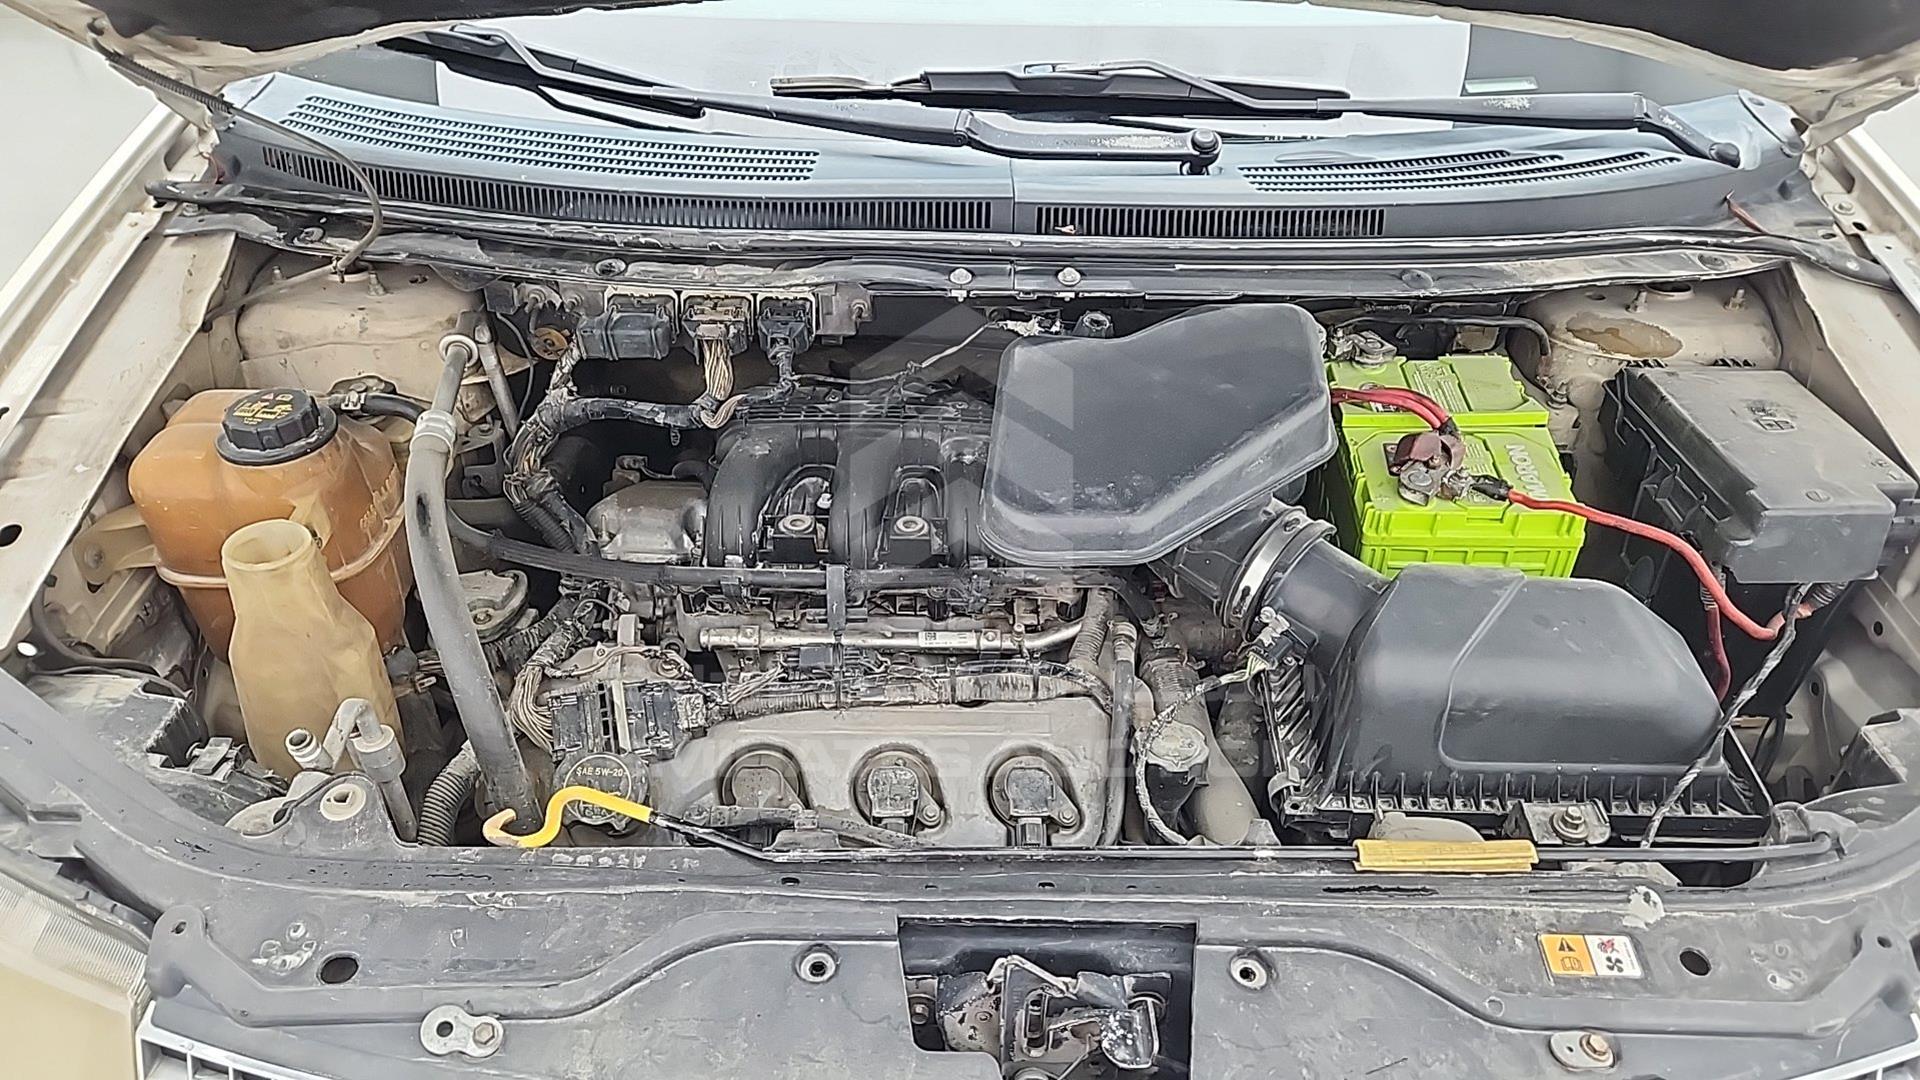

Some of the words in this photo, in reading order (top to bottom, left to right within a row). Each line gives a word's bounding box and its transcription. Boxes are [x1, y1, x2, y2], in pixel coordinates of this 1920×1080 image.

[1505, 444, 1548, 498] MARON
[575, 766, 594, 777] SAE
[595, 767, 624, 777] 5W-20
